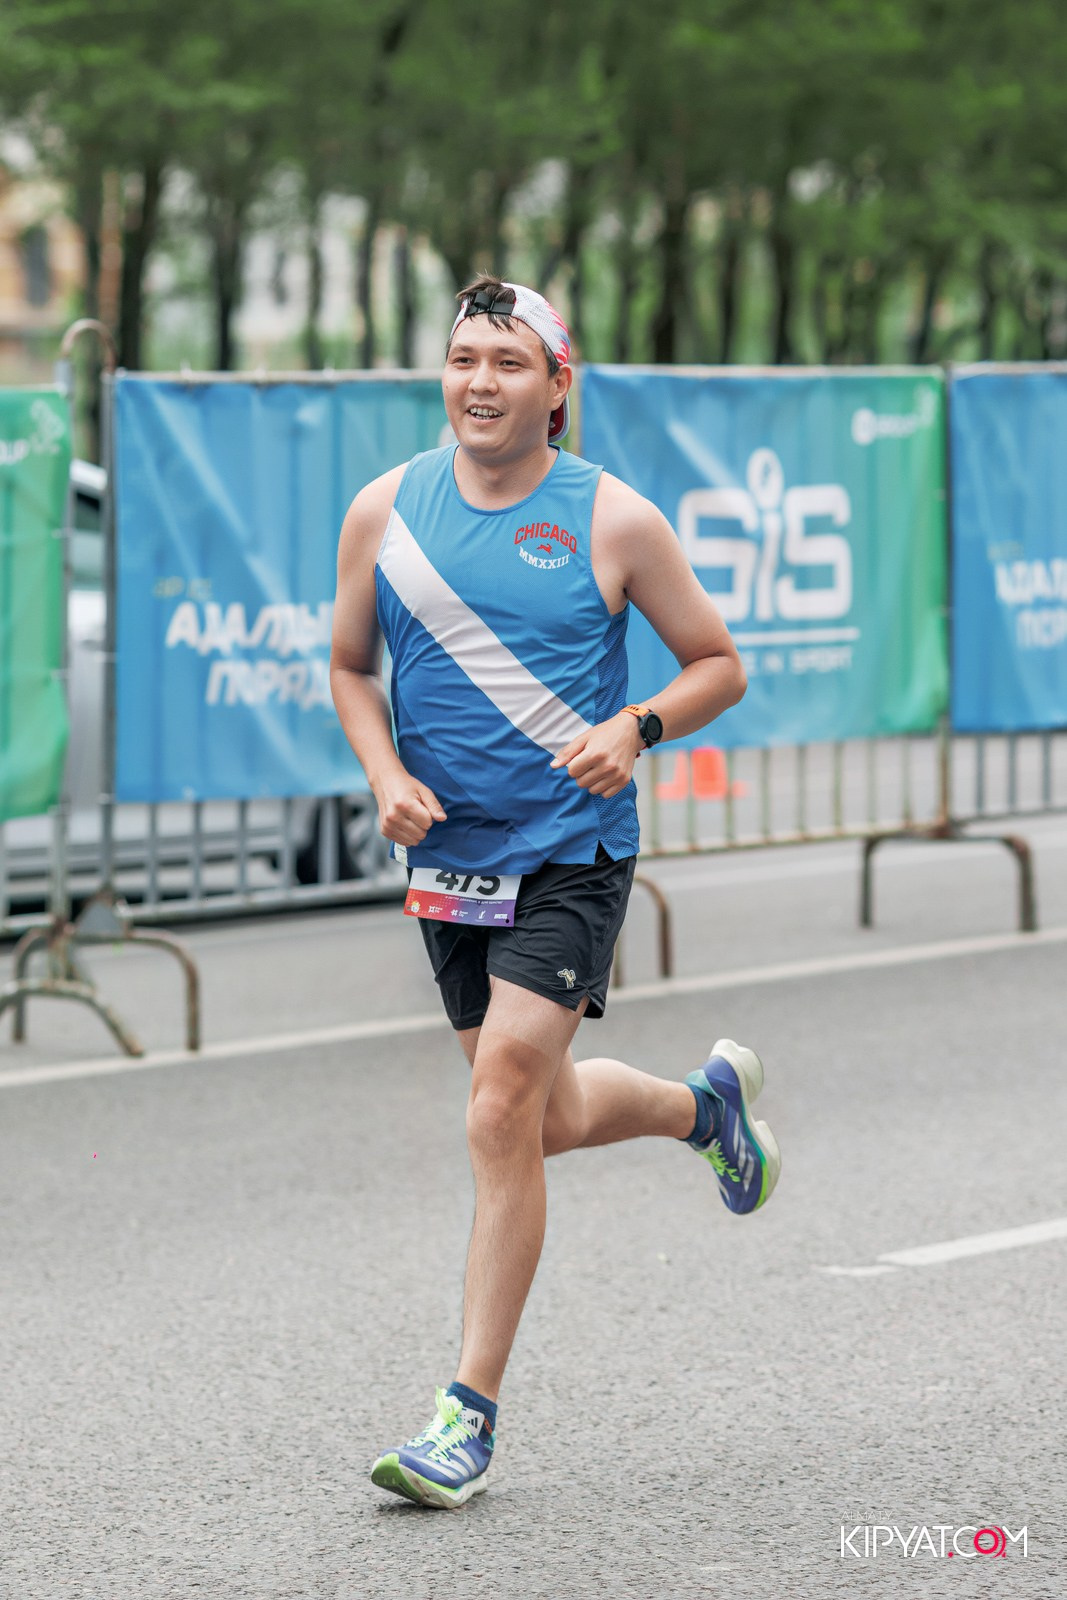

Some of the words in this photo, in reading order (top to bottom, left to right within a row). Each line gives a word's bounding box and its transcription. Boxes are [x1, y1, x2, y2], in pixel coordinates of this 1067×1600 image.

[514, 522, 577, 554] CHICAGO
[519, 546, 570, 569] MMXXIII
[165, 601, 335, 656] АДАЛДЫ
[205, 659, 335, 710] ПОРЯД
